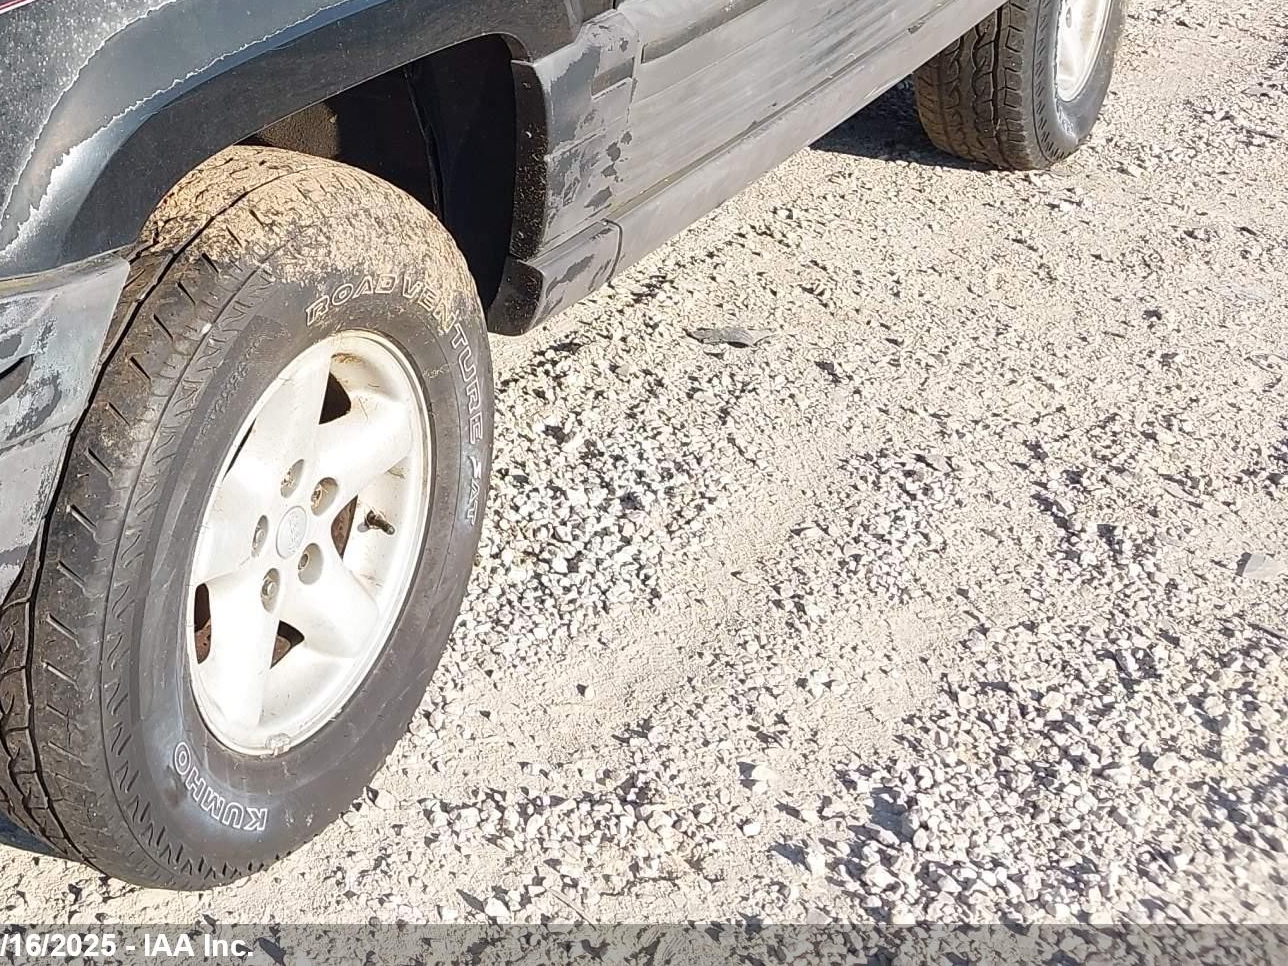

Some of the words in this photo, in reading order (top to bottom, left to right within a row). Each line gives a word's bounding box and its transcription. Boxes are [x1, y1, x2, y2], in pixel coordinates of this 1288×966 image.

[305, 273, 397, 327] ROAD
[402, 275, 483, 445] VENTURE
[175, 742, 268, 831] KUMHO
